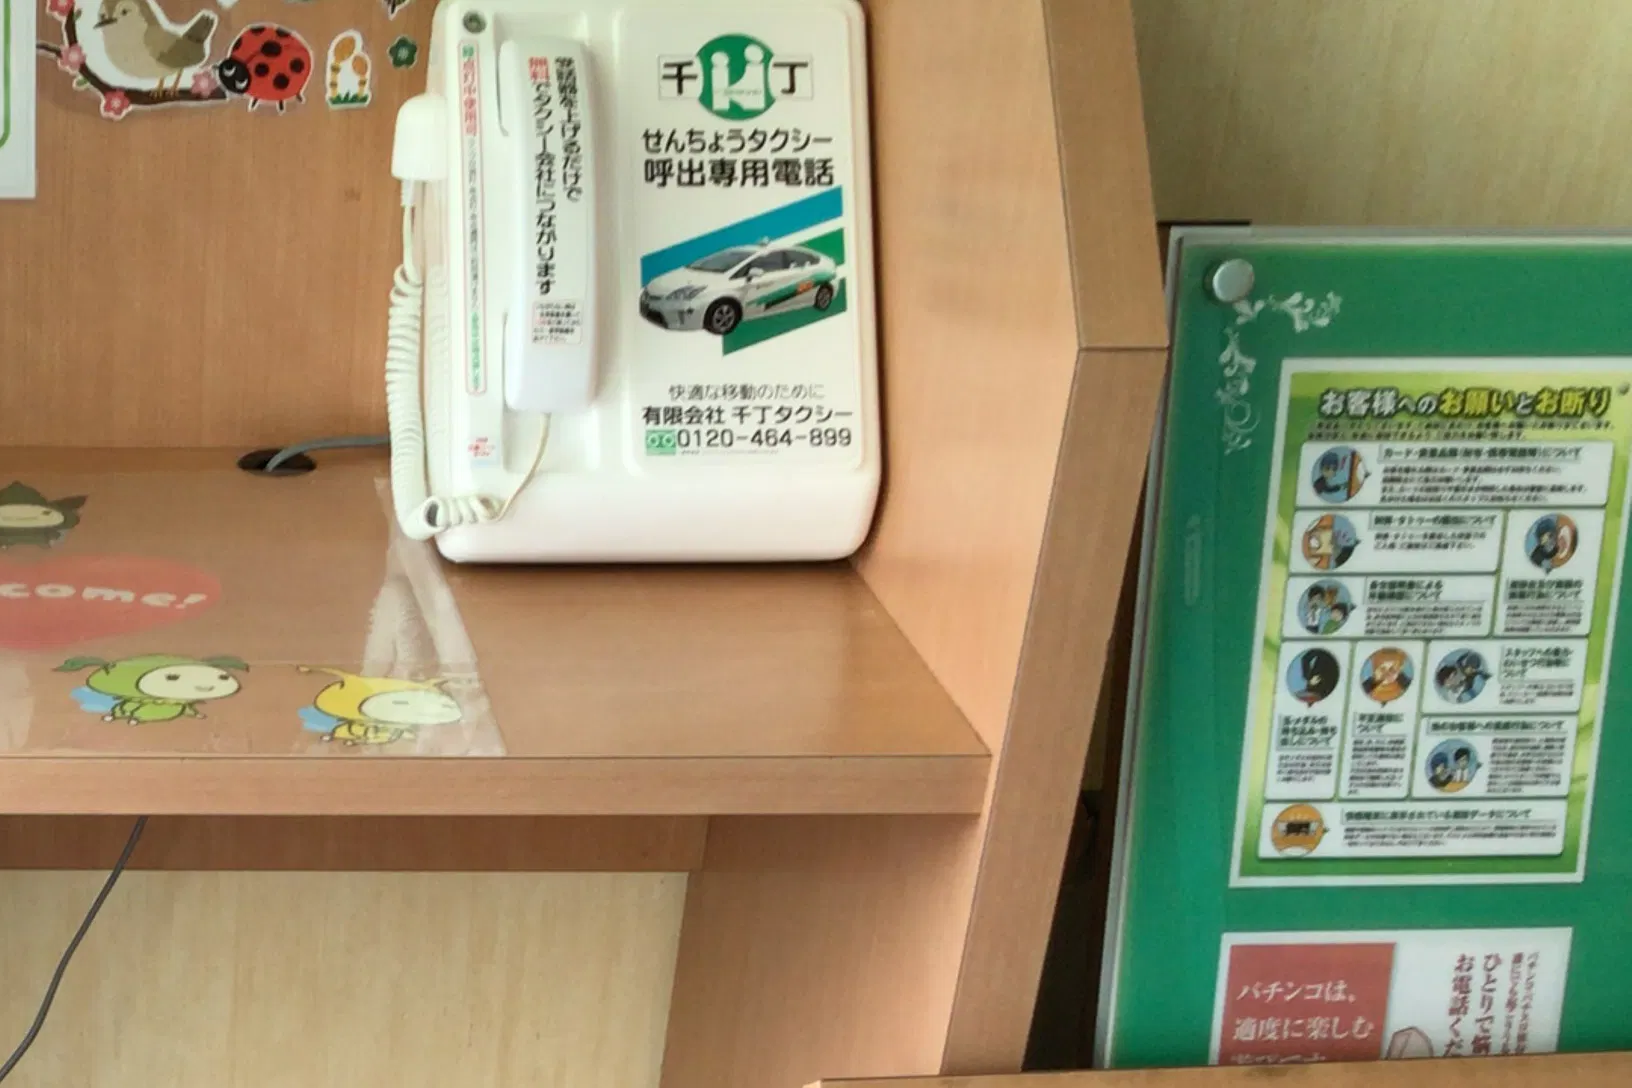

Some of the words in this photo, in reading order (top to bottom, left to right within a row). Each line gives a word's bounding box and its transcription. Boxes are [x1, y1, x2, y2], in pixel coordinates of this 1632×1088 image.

[662, 60, 699, 96] 千
[772, 61, 809, 95] 丁
[642, 127, 834, 154] せんちょうタクシー
[643, 157, 835, 188] 呼出専用電話
[668, 384, 826, 401] 快適な移動のために
[1319, 386, 1612, 418] お客様へのお願いとお断り
[642, 405, 726, 425] 有限会社
[731, 405, 854, 425] 千丁タクシー
[676, 428, 853, 448] 0120-464-899
[1232, 1016, 1375, 1041] 適度に楽しむ
